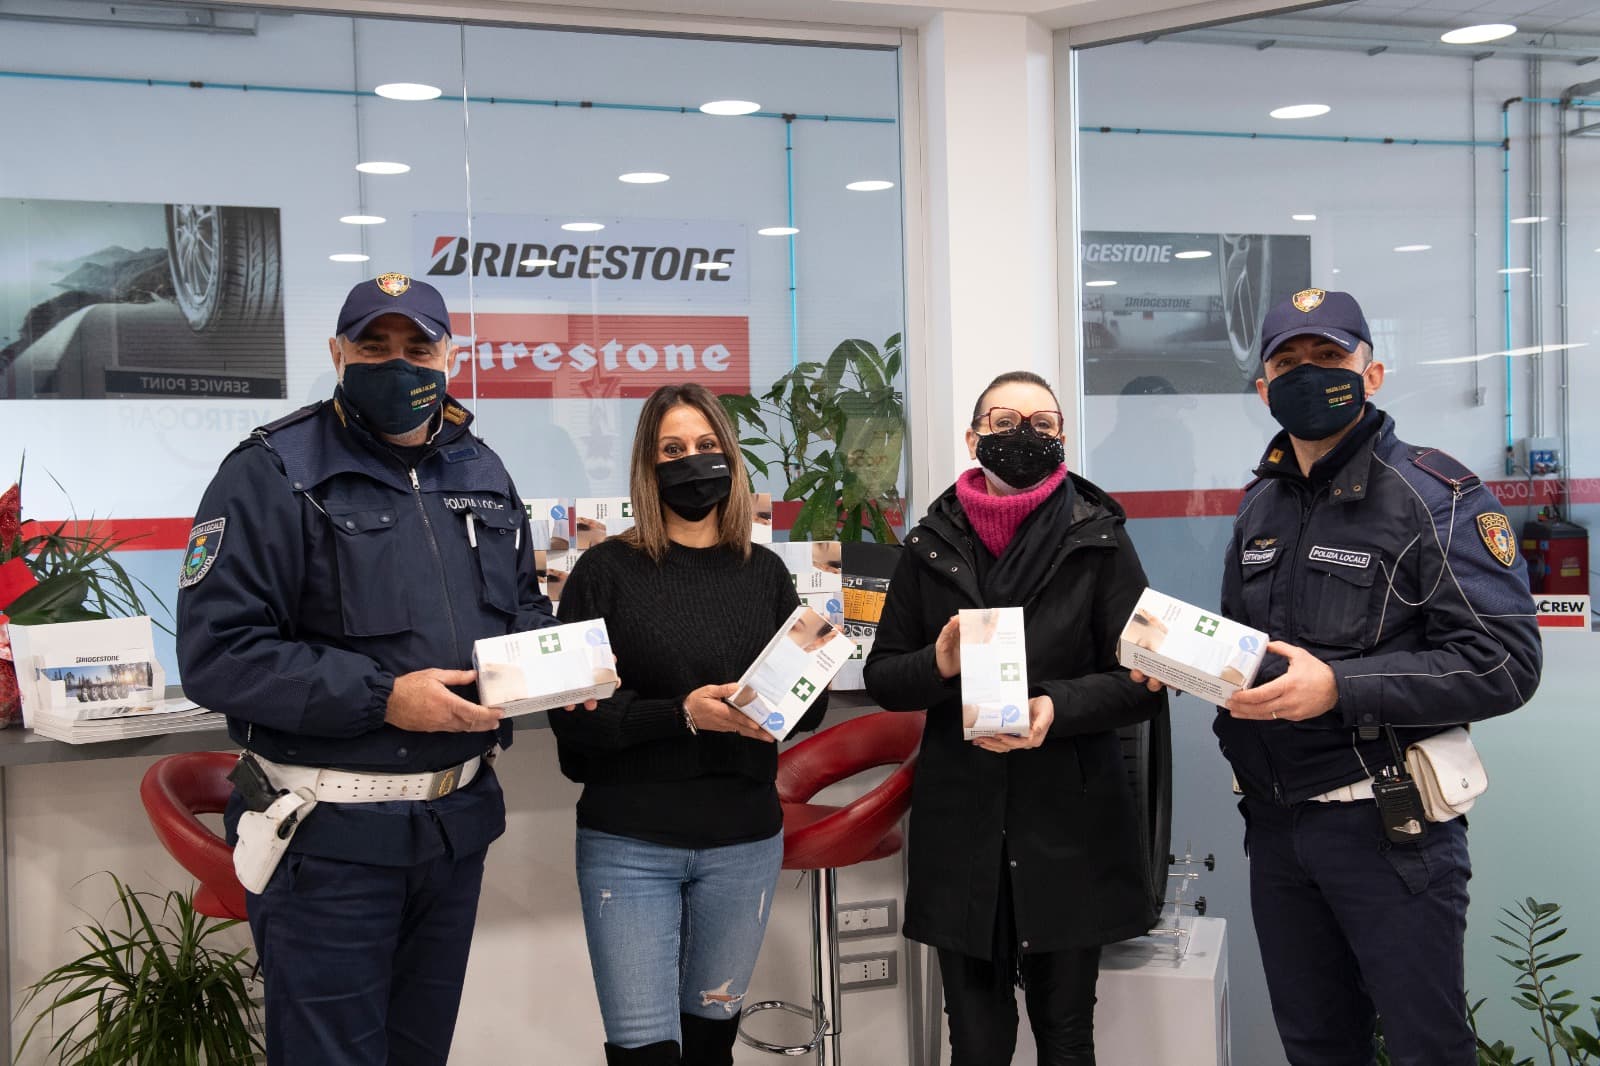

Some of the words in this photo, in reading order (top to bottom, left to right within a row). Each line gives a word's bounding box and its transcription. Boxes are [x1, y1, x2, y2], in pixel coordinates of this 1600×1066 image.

[427, 236, 735, 281] BRIDGESTONE
[1313, 549, 1338, 560] POLIZIA
[1339, 553, 1367, 564] LOCALE
